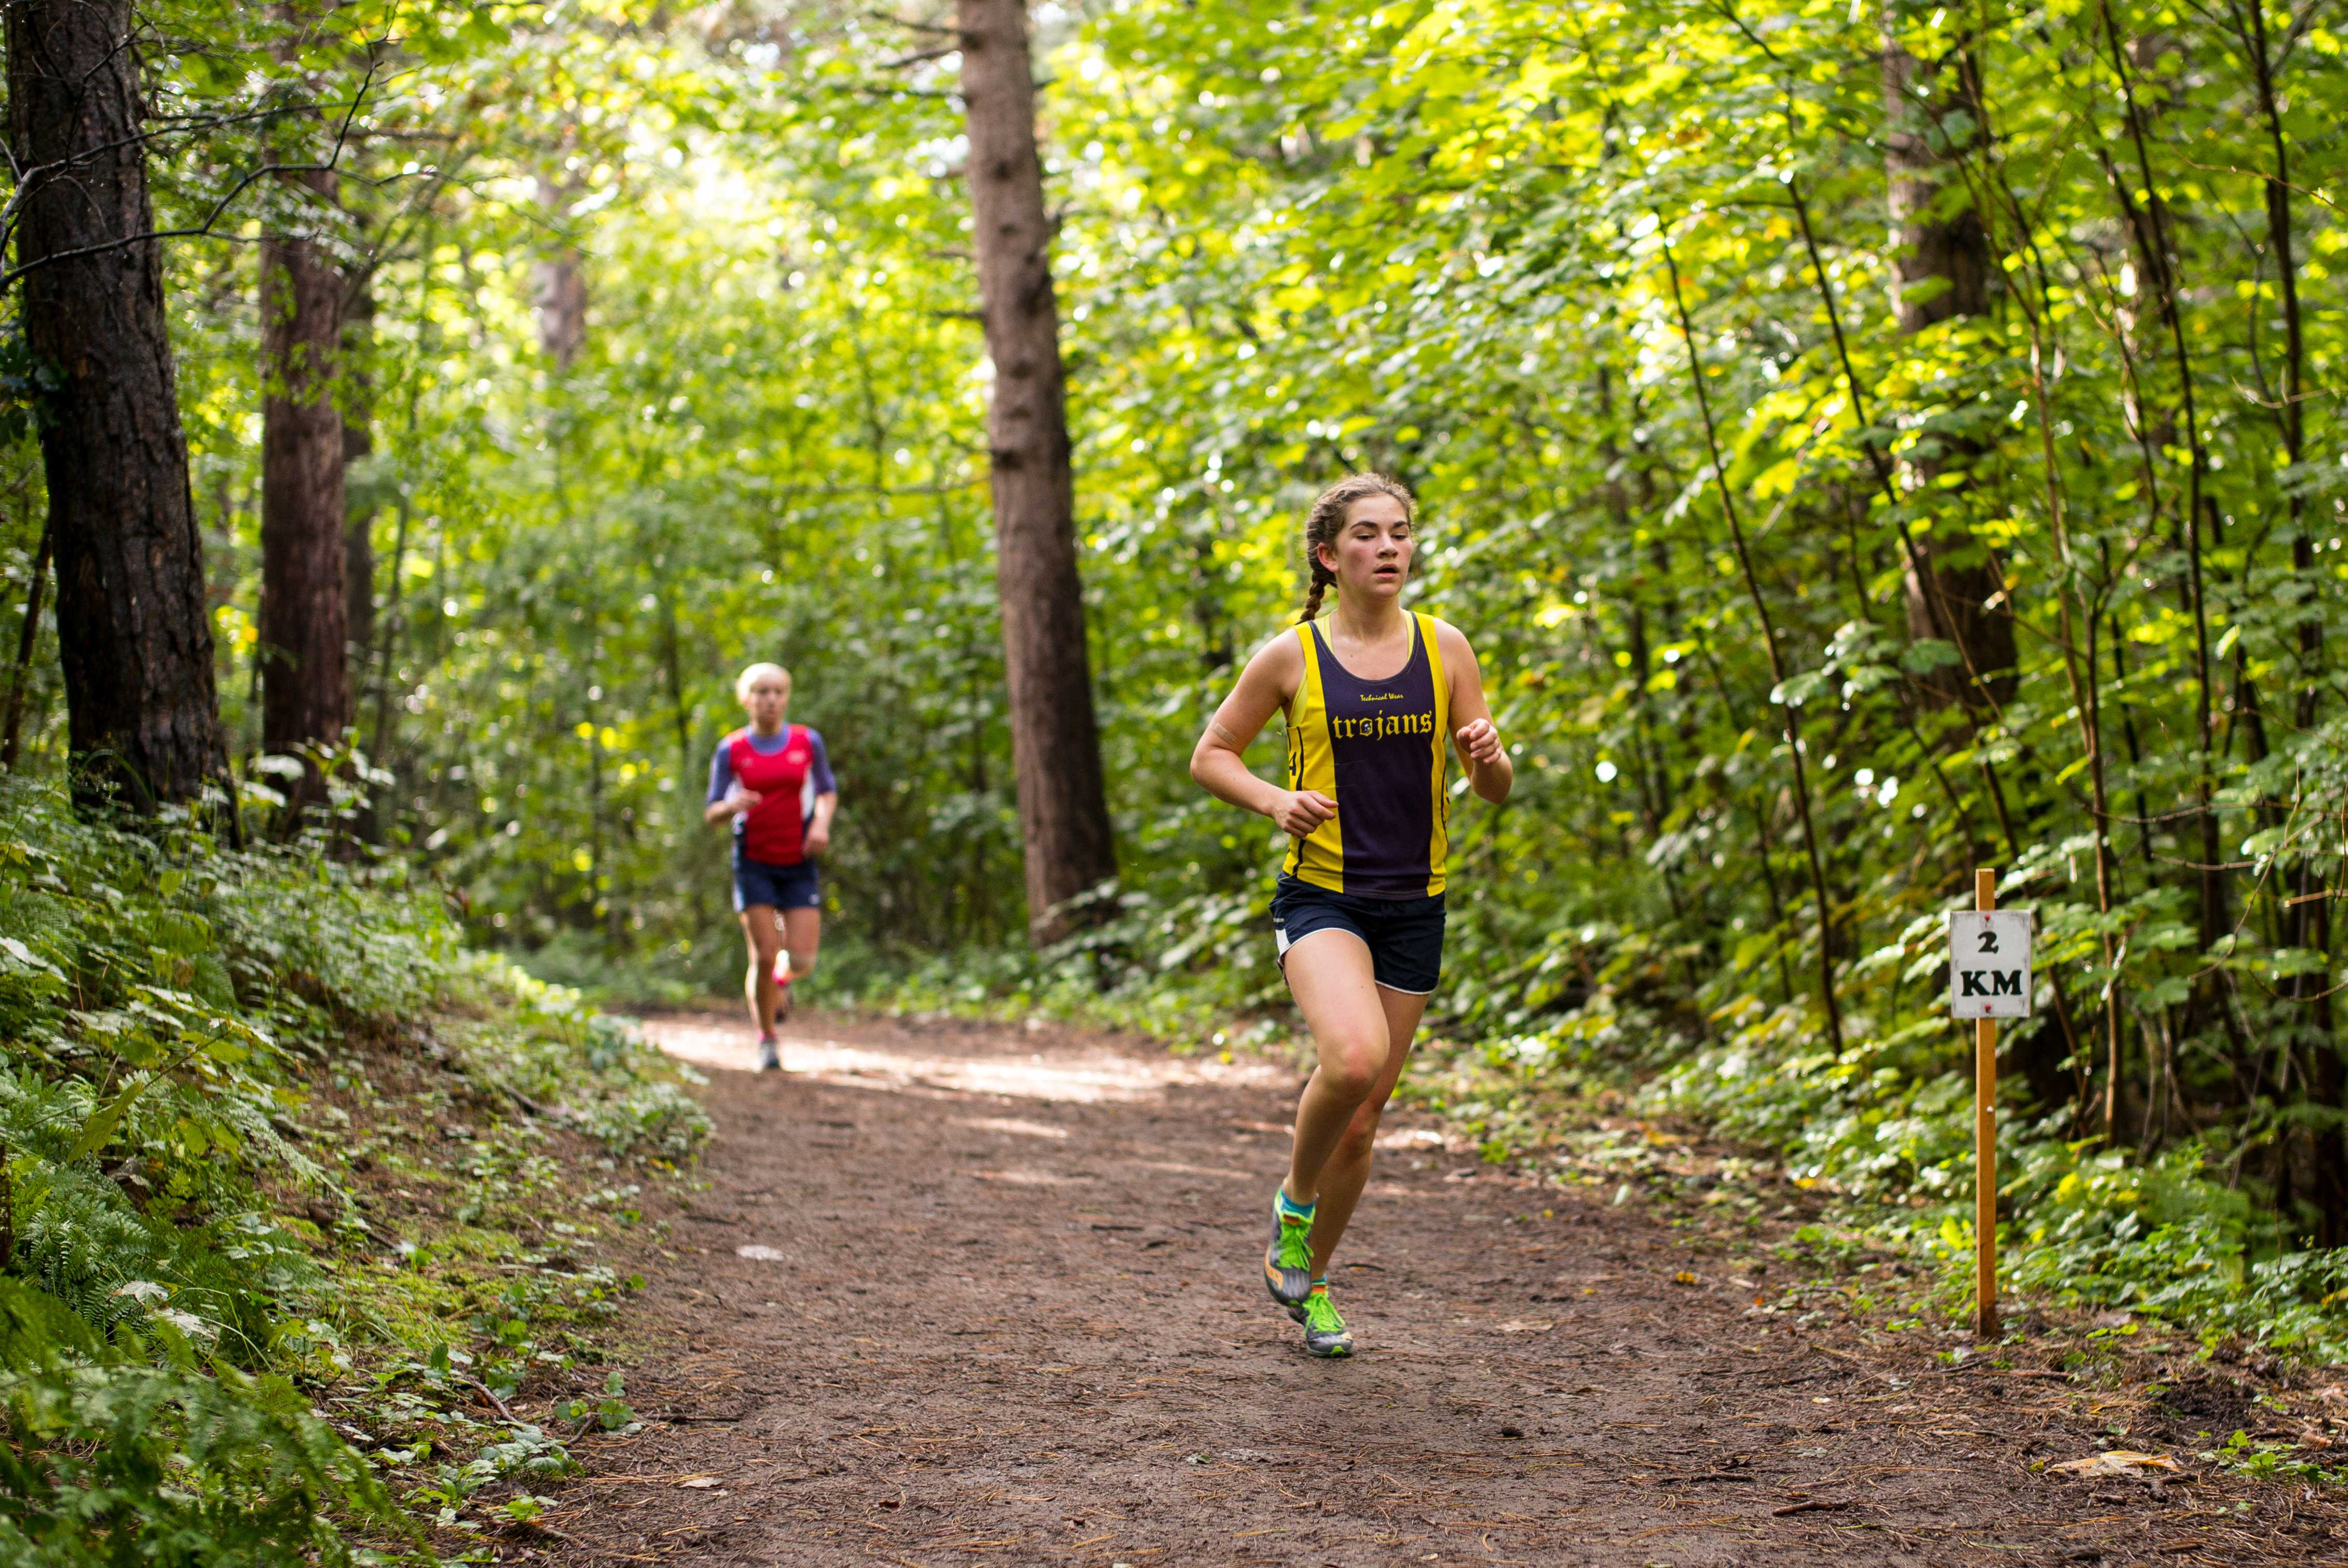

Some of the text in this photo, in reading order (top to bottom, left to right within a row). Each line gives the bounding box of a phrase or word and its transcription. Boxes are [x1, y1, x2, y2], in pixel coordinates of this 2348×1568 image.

[1360, 693, 1387, 702] Technical
[1333, 710, 1432, 740] trojans
[1978, 931, 1999, 954] 2
[1960, 970, 2023, 996] KM
